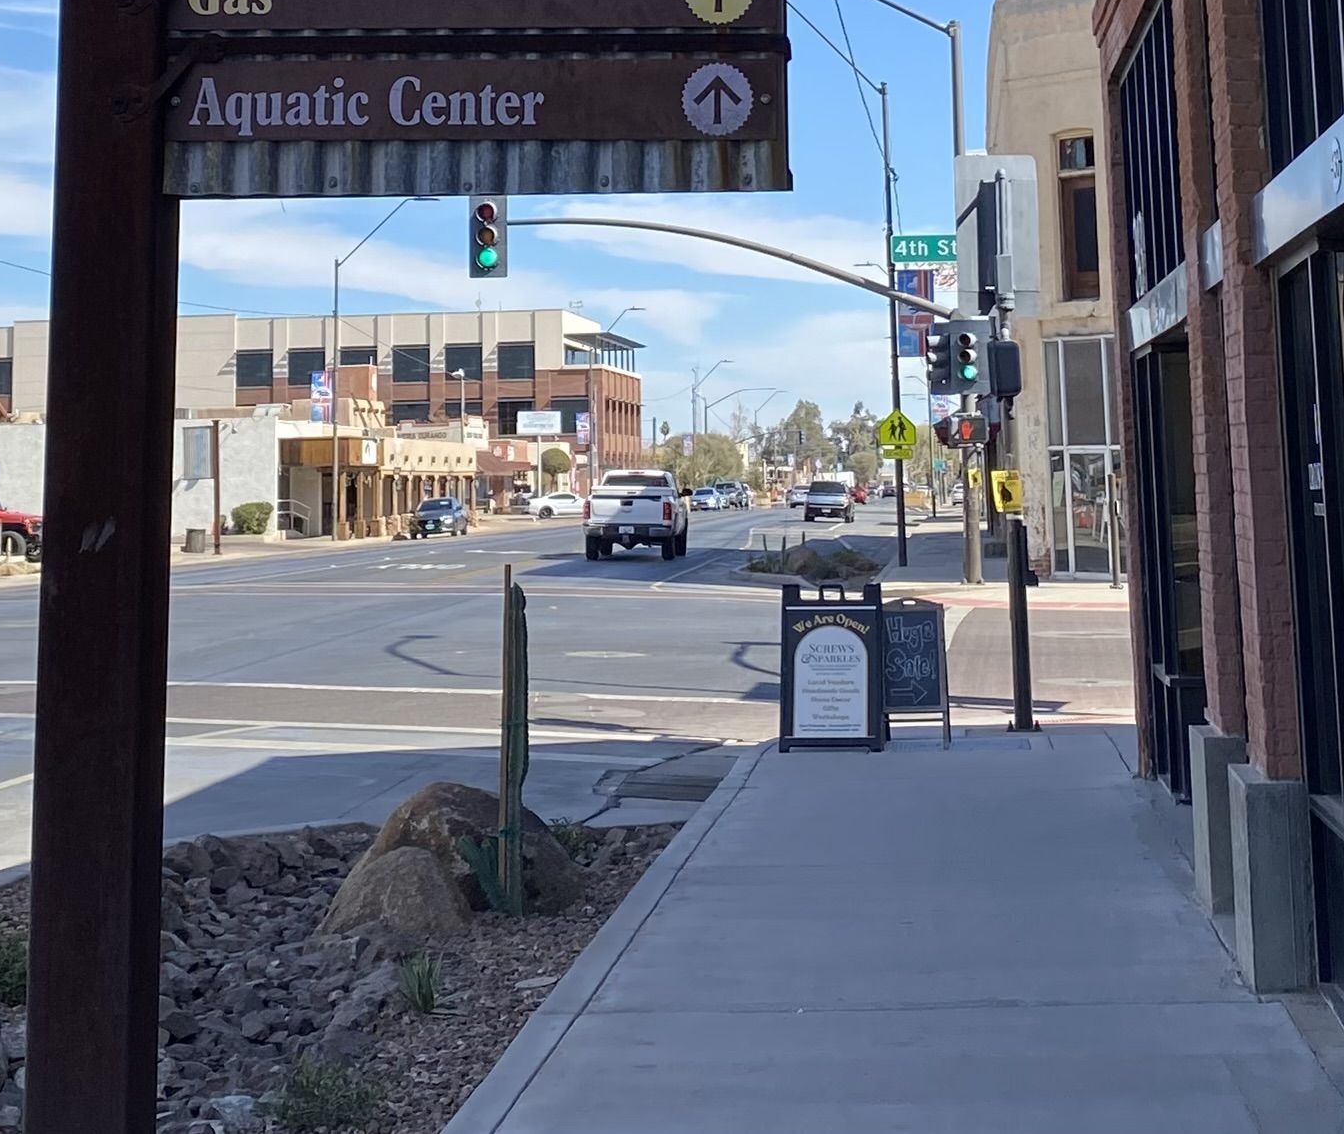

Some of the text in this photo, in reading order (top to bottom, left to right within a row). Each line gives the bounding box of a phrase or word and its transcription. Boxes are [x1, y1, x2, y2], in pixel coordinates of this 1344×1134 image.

[188, 75, 544, 136] Aquatic Center
[894, 239, 957, 257] 4th St
[792, 613, 871, 635] We Are Open!
[885, 616, 936, 654] Huge
[809, 643, 855, 654] SCREWS
[885, 647, 937, 682] Sale!
